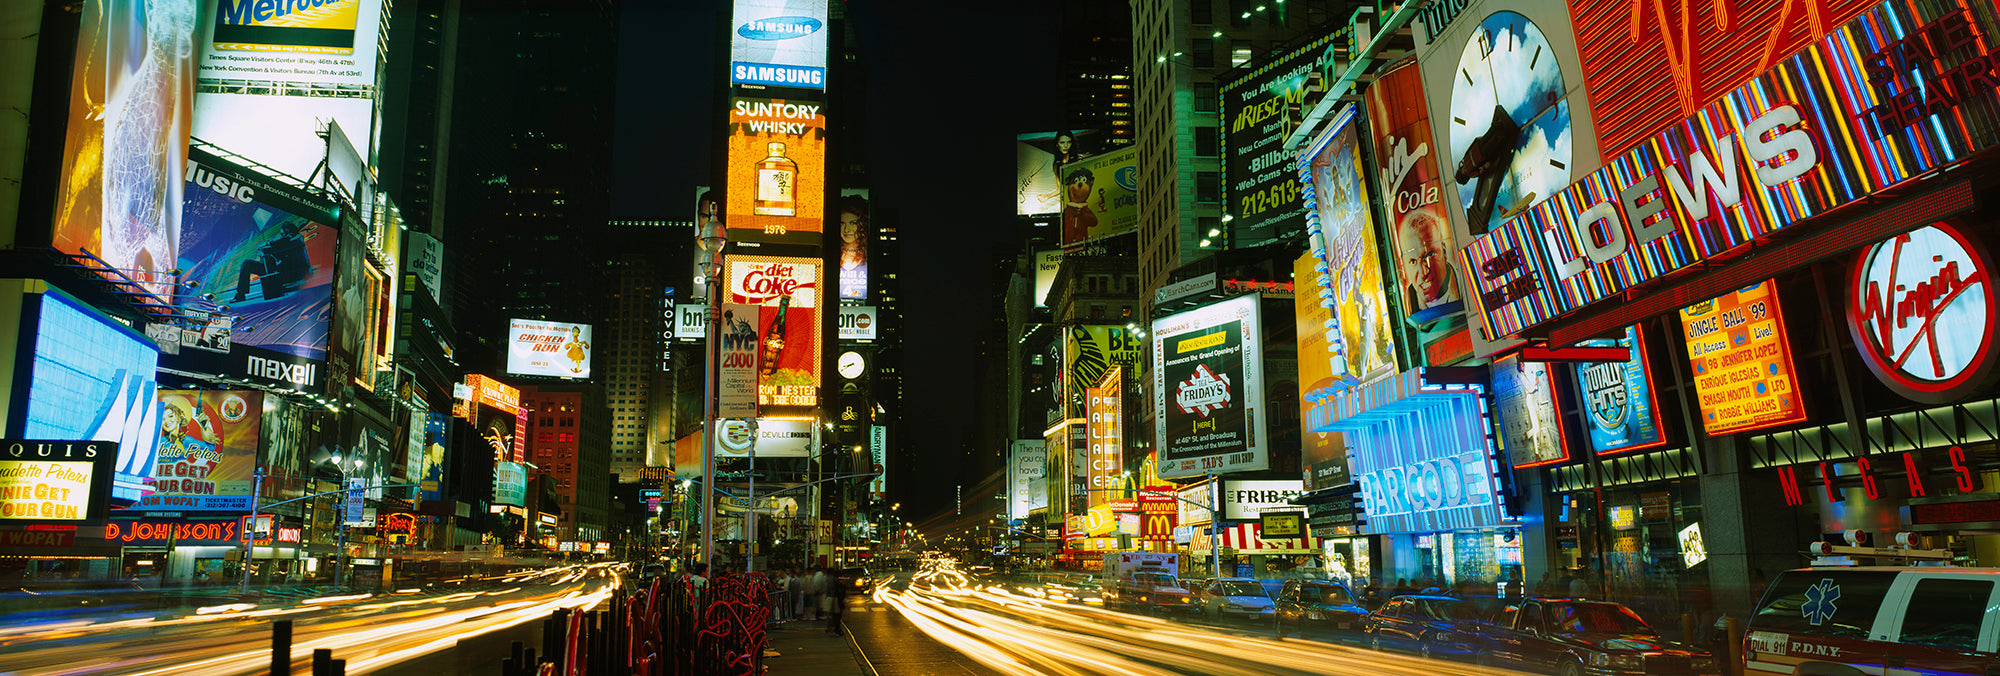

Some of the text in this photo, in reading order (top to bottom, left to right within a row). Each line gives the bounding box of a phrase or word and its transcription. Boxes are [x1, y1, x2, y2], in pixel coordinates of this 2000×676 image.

[747, 20, 812, 35] SAMSUNG
[1863, 7, 1980, 87] STATE
[735, 65, 822, 85] SAMSUNG
[1242, 60, 1314, 103] You Are Looking
[735, 100, 820, 120] SUNTORY
[749, 120, 806, 135] WHISKY
[1238, 146, 1253, 157] New
[1238, 167, 1281, 191] Web Cams
[1397, 183, 1440, 214] Cola
[1543, 104, 1819, 281] LOEWS
[763, 224, 787, 235] 1976
[765, 263, 794, 278] diet
[1040, 262, 1057, 272] New
[742, 270, 798, 296] Coke
[1167, 279, 1214, 298] EarthCam.com
[1863, 232, 1981, 378] Virgin
[1722, 307, 1746, 329] BALL
[1748, 301, 1767, 320] '99
[518, 333, 566, 344] CHICKEN
[662, 298, 674, 372] NOVOTEL
[722, 333, 758, 352] NYC
[1693, 322, 1773, 357] All Access Live!
[532, 343, 561, 353] RUN
[1165, 344, 1240, 367] Announces the Grand Opening of
[1755, 342, 1778, 359] LOPEZ
[722, 352, 755, 369] 2000
[247, 355, 316, 386] maxell
[1584, 361, 1625, 392] TOTALLY
[1184, 383, 1224, 402] FRIDAY'S
[1588, 383, 1628, 413] HITS
[1703, 378, 1786, 407] SMASH MOUTH LFO
[1197, 420, 1212, 429] HERE
[1606, 408, 1619, 426] 2
[762, 431, 790, 439] DEVILLE
[1200, 434, 1210, 442] and
[1210, 431, 1237, 441] Broadway
[1018, 444, 1034, 453] The
[1179, 444, 1204, 452] Crossroads
[1217, 440, 1243, 448] Millennium
[1201, 456, 1224, 470] TAD'S
[1229, 454, 1241, 465] JAVA
[45, 463, 88, 484] Peters
[175, 461, 208, 479] GET
[1019, 465, 1039, 475] have
[1777, 446, 1974, 507] MEGAS
[34, 483, 71, 501] GET
[181, 478, 216, 495] GUN
[1360, 469, 1405, 517] BAR
[1406, 453, 1491, 512] CODE
[41, 501, 79, 519] GUN
[162, 497, 201, 507] WOPAT
[9, 531, 66, 547] WOPAT
[1752, 639, 1786, 655] DIAL 911
[1791, 641, 1841, 658] F.D.N.Y.
